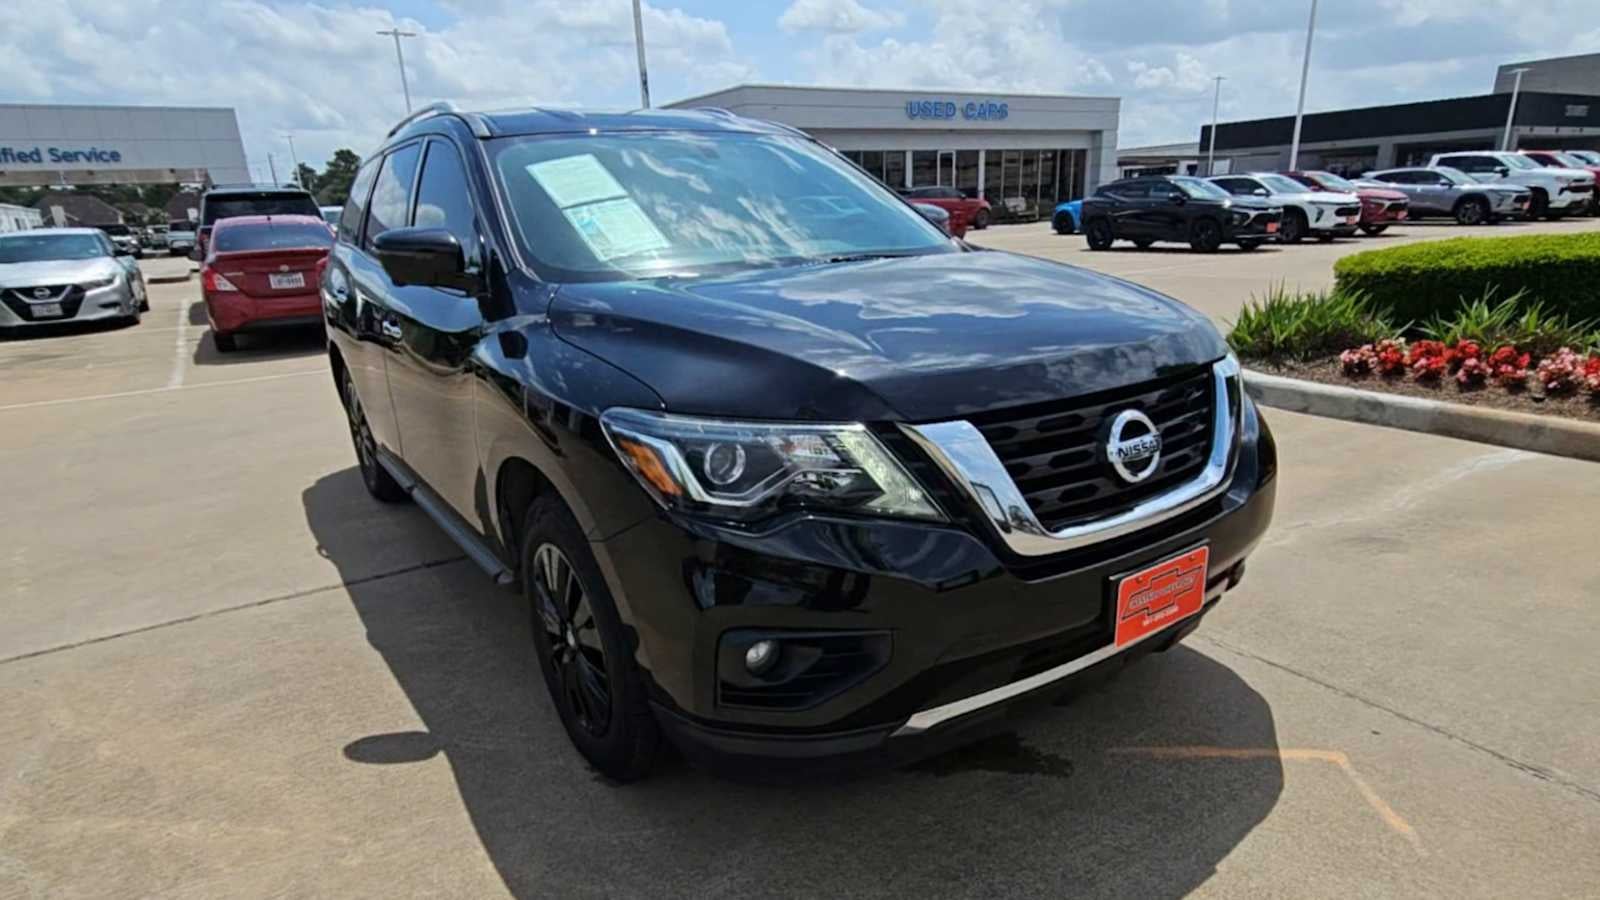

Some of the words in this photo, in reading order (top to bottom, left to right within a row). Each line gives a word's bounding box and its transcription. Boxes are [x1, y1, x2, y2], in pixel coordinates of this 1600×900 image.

[906, 101, 957, 119] USED
[963, 101, 1009, 120] CARS
[0, 147, 42, 163] fied
[48, 147, 121, 163] Service
